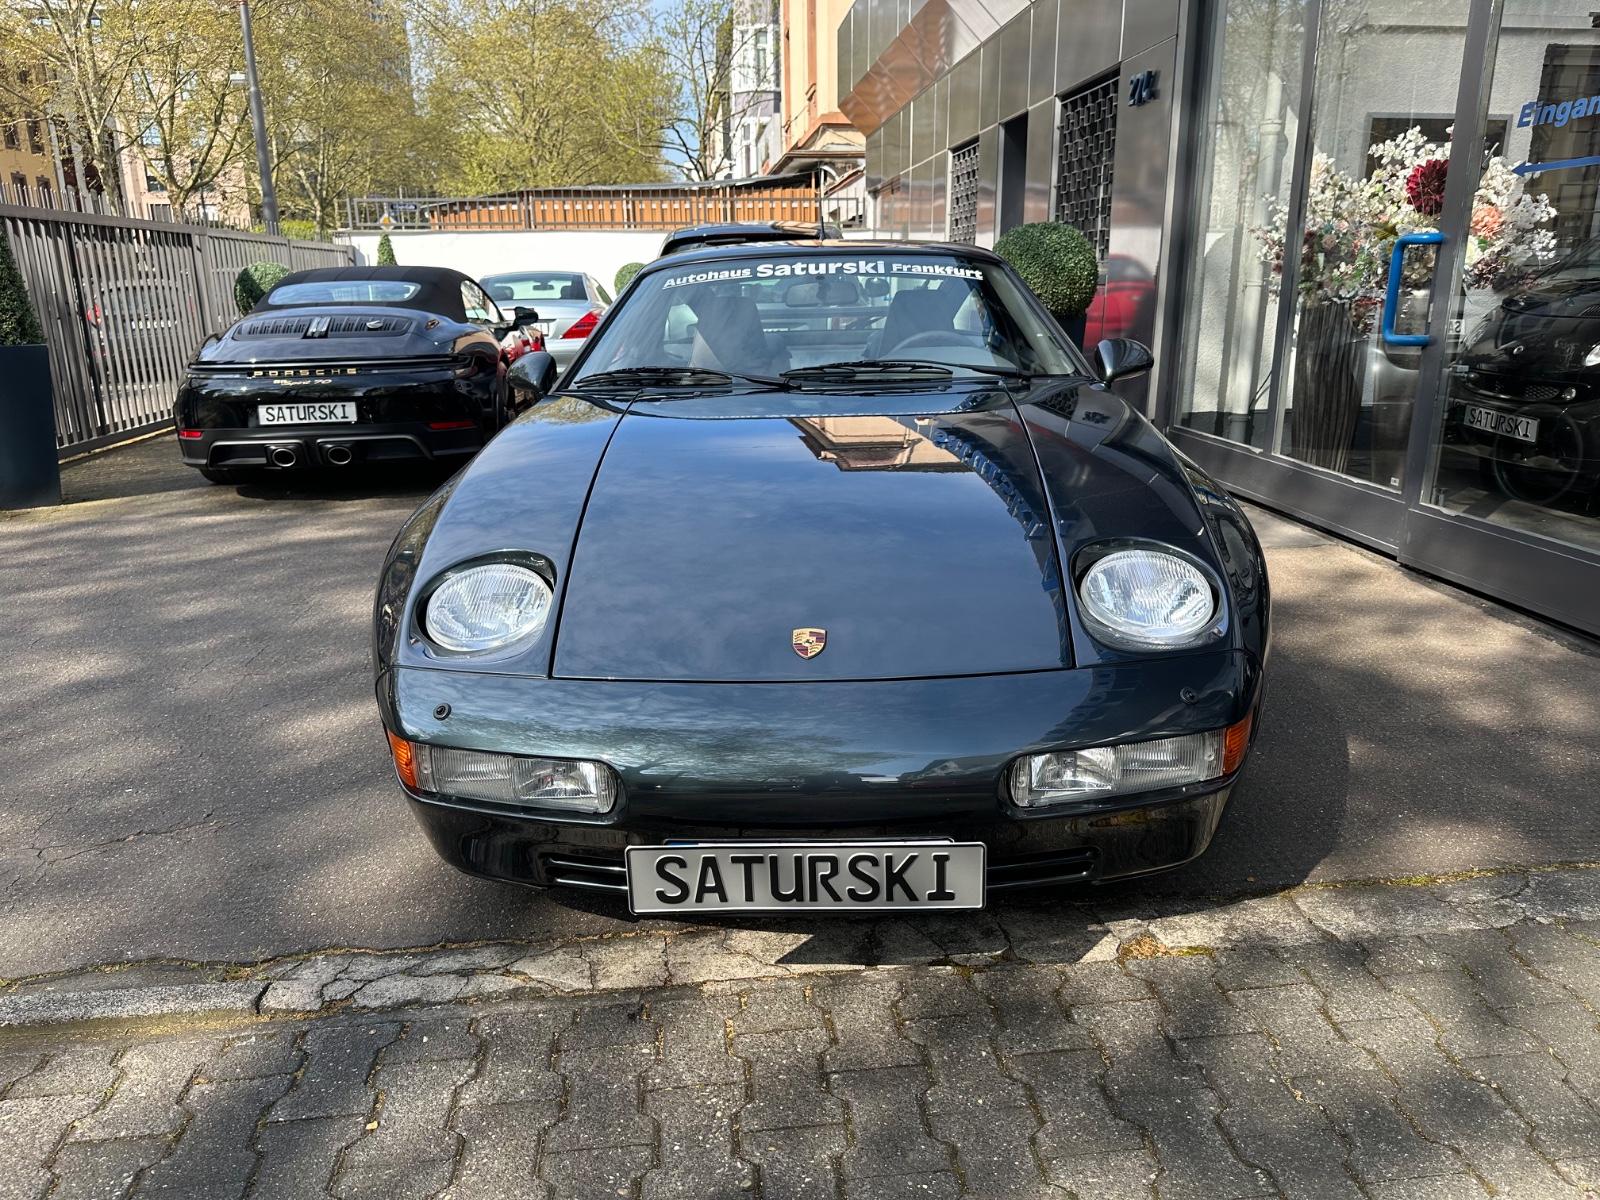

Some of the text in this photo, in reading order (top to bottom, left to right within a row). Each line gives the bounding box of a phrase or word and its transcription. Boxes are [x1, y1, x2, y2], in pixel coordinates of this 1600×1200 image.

[663, 260, 984, 288] Autohaus Saturski Frankfurt
[253, 367, 357, 378] PORSCHE
[265, 404, 350, 422] SATURSKI
[1468, 407, 1531, 438] SATURSKI
[655, 852, 956, 904] SATURSKI
